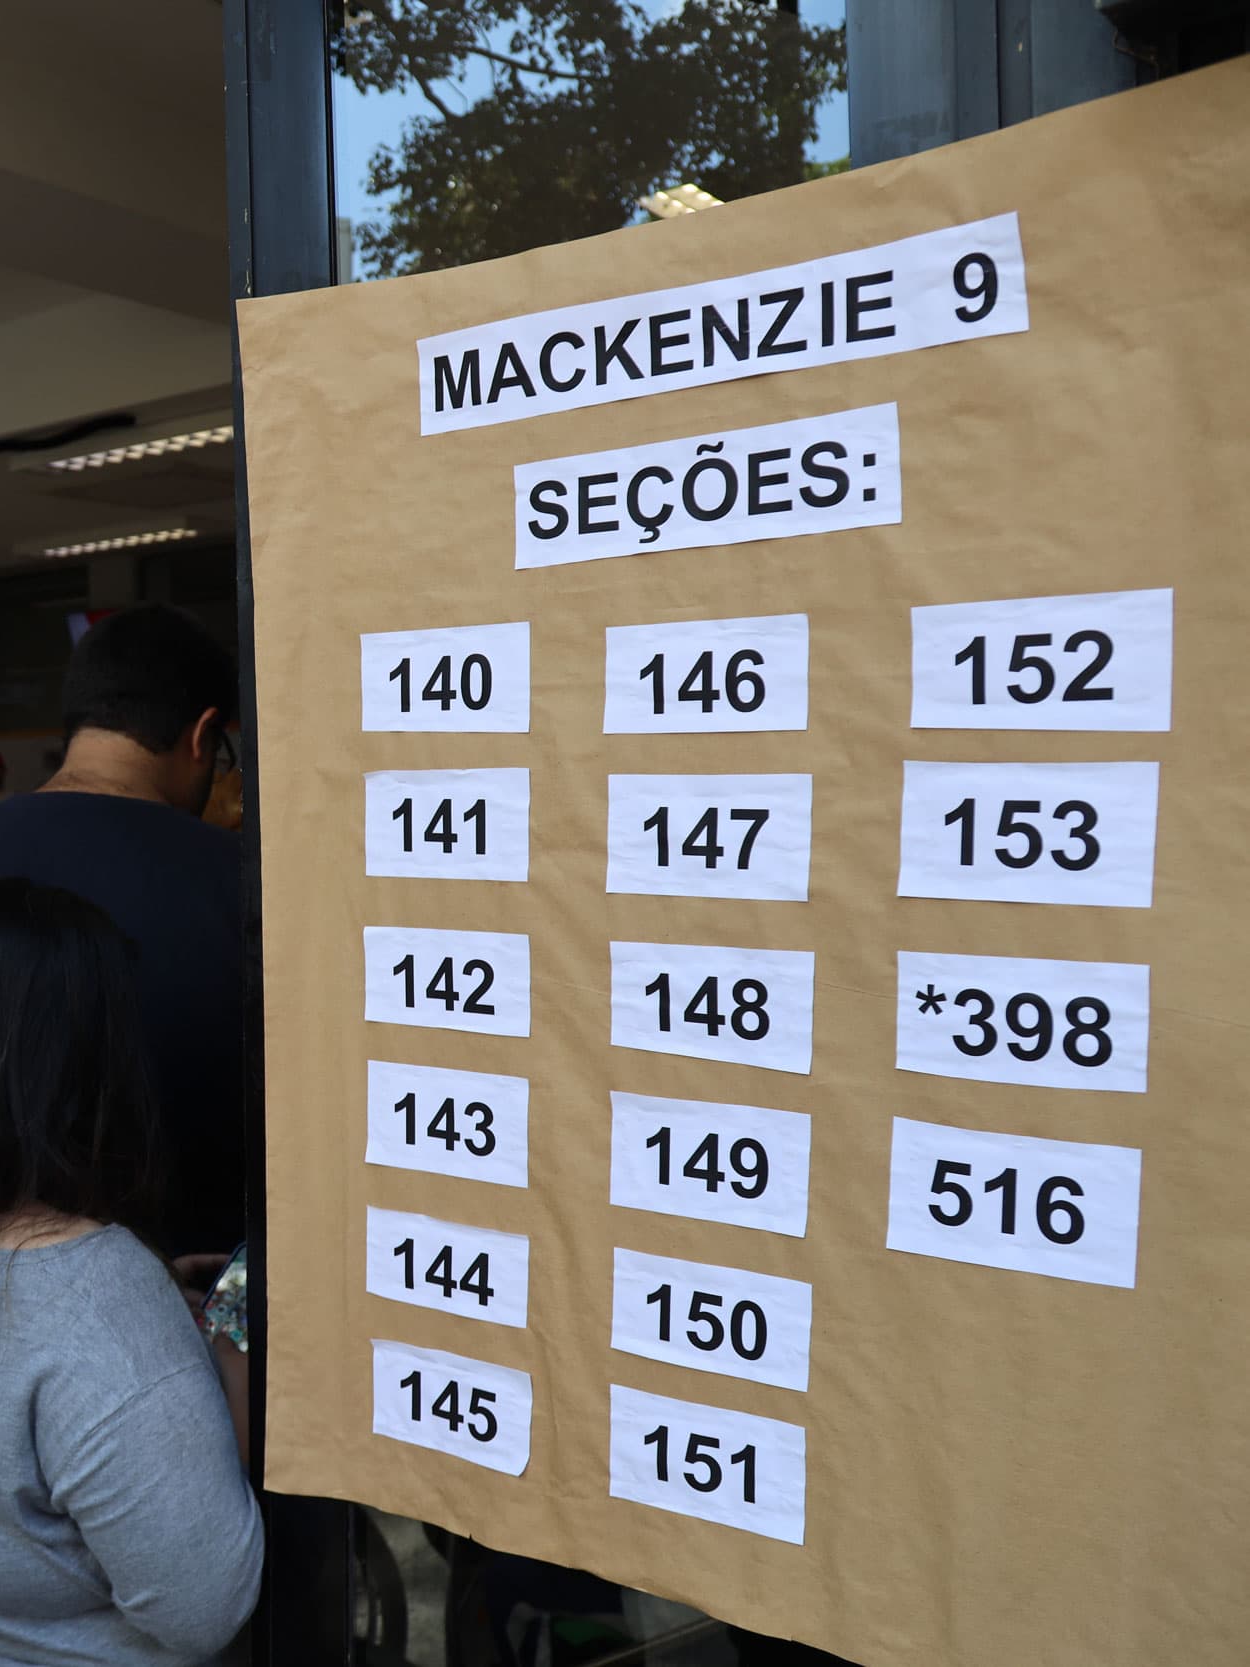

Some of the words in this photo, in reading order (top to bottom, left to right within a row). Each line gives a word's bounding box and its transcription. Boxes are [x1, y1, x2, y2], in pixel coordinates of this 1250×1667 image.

[433, 270, 897, 414] MACKENZIE
[953, 252, 998, 323] 9
[528, 441, 876, 544] SEÇÕES:
[389, 653, 492, 713] 140
[639, 649, 766, 715] 146
[955, 630, 1114, 705] 152
[392, 798, 486, 855] 141
[643, 806, 770, 870] 147
[944, 798, 1100, 872] 153
[393, 954, 495, 1016] 142
[645, 972, 770, 1041] 148
[394, 1092, 496, 1157] 143
[646, 1126, 769, 1199] 149
[928, 1159, 1085, 1245] 516
[393, 1238, 495, 1307] 144
[646, 1283, 768, 1361] 150
[400, 1370, 498, 1443] 145
[644, 1425, 756, 1504] 151
